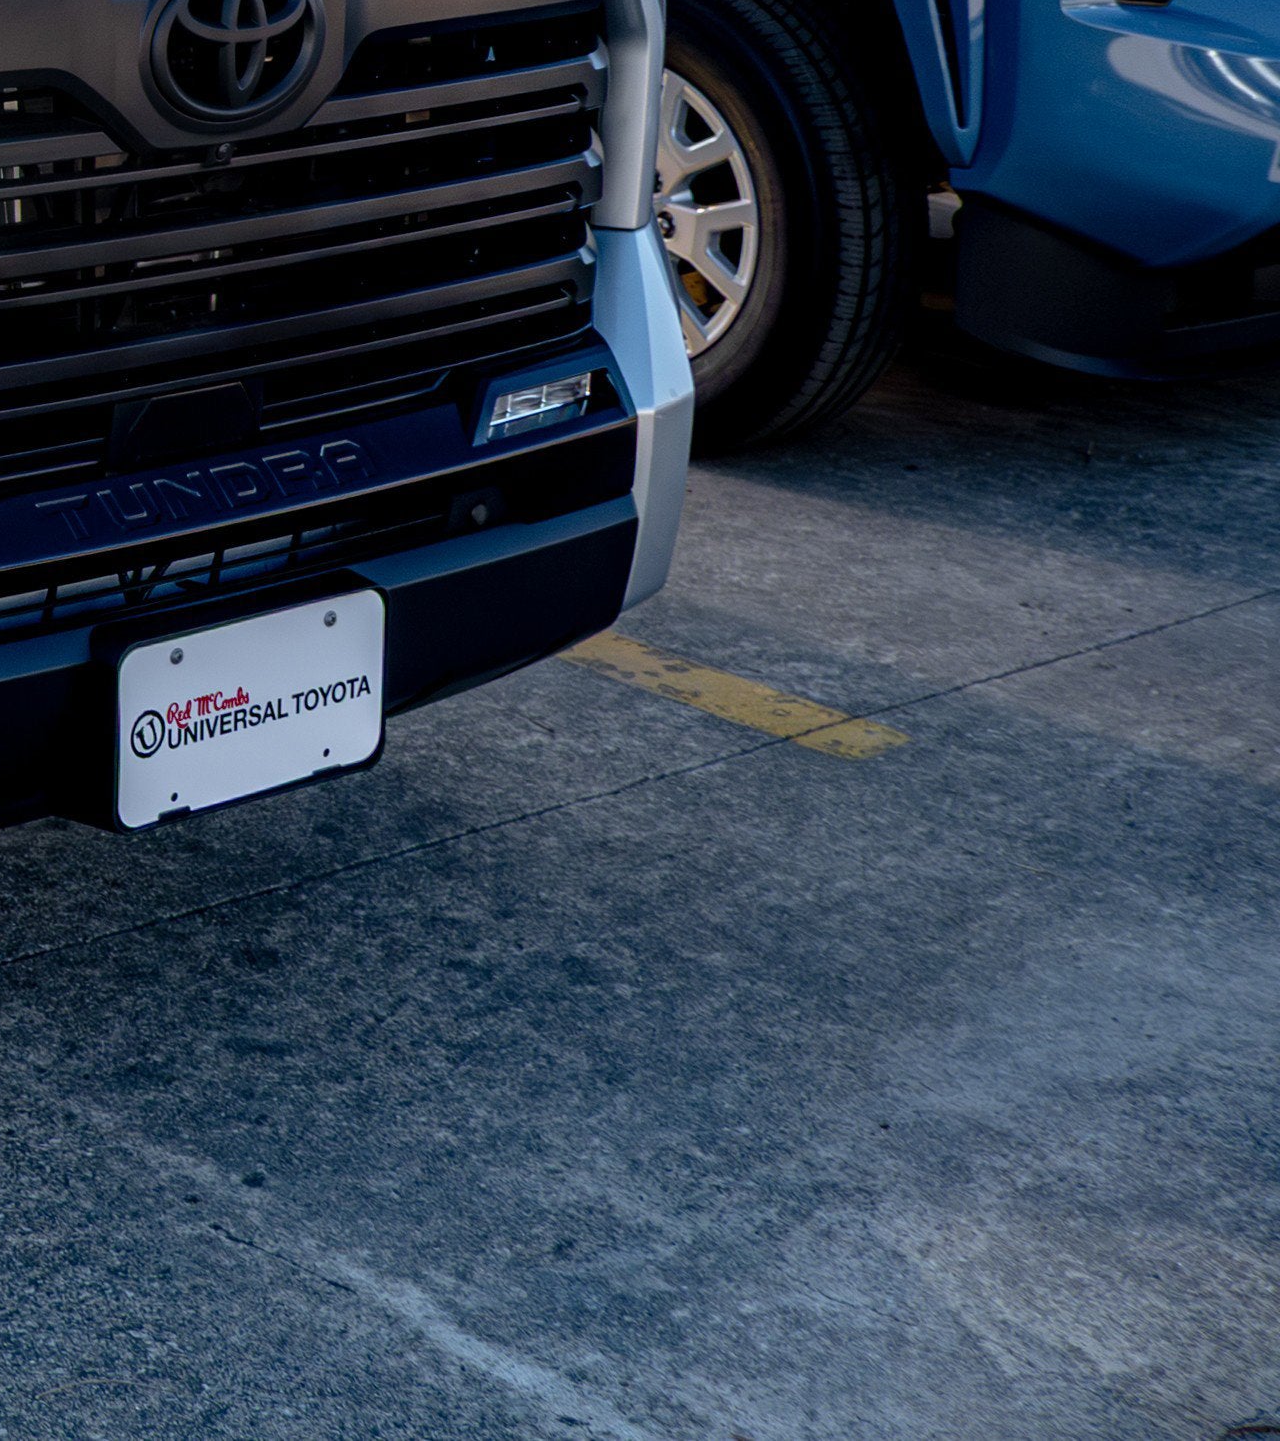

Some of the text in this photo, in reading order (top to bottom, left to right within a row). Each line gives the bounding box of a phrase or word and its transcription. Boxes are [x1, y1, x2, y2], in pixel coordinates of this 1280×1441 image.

[35, 438, 377, 541] TUNDRA
[166, 686, 250, 729] Red McCombs
[168, 675, 371, 749] UNIVERSAL TOYOTA
